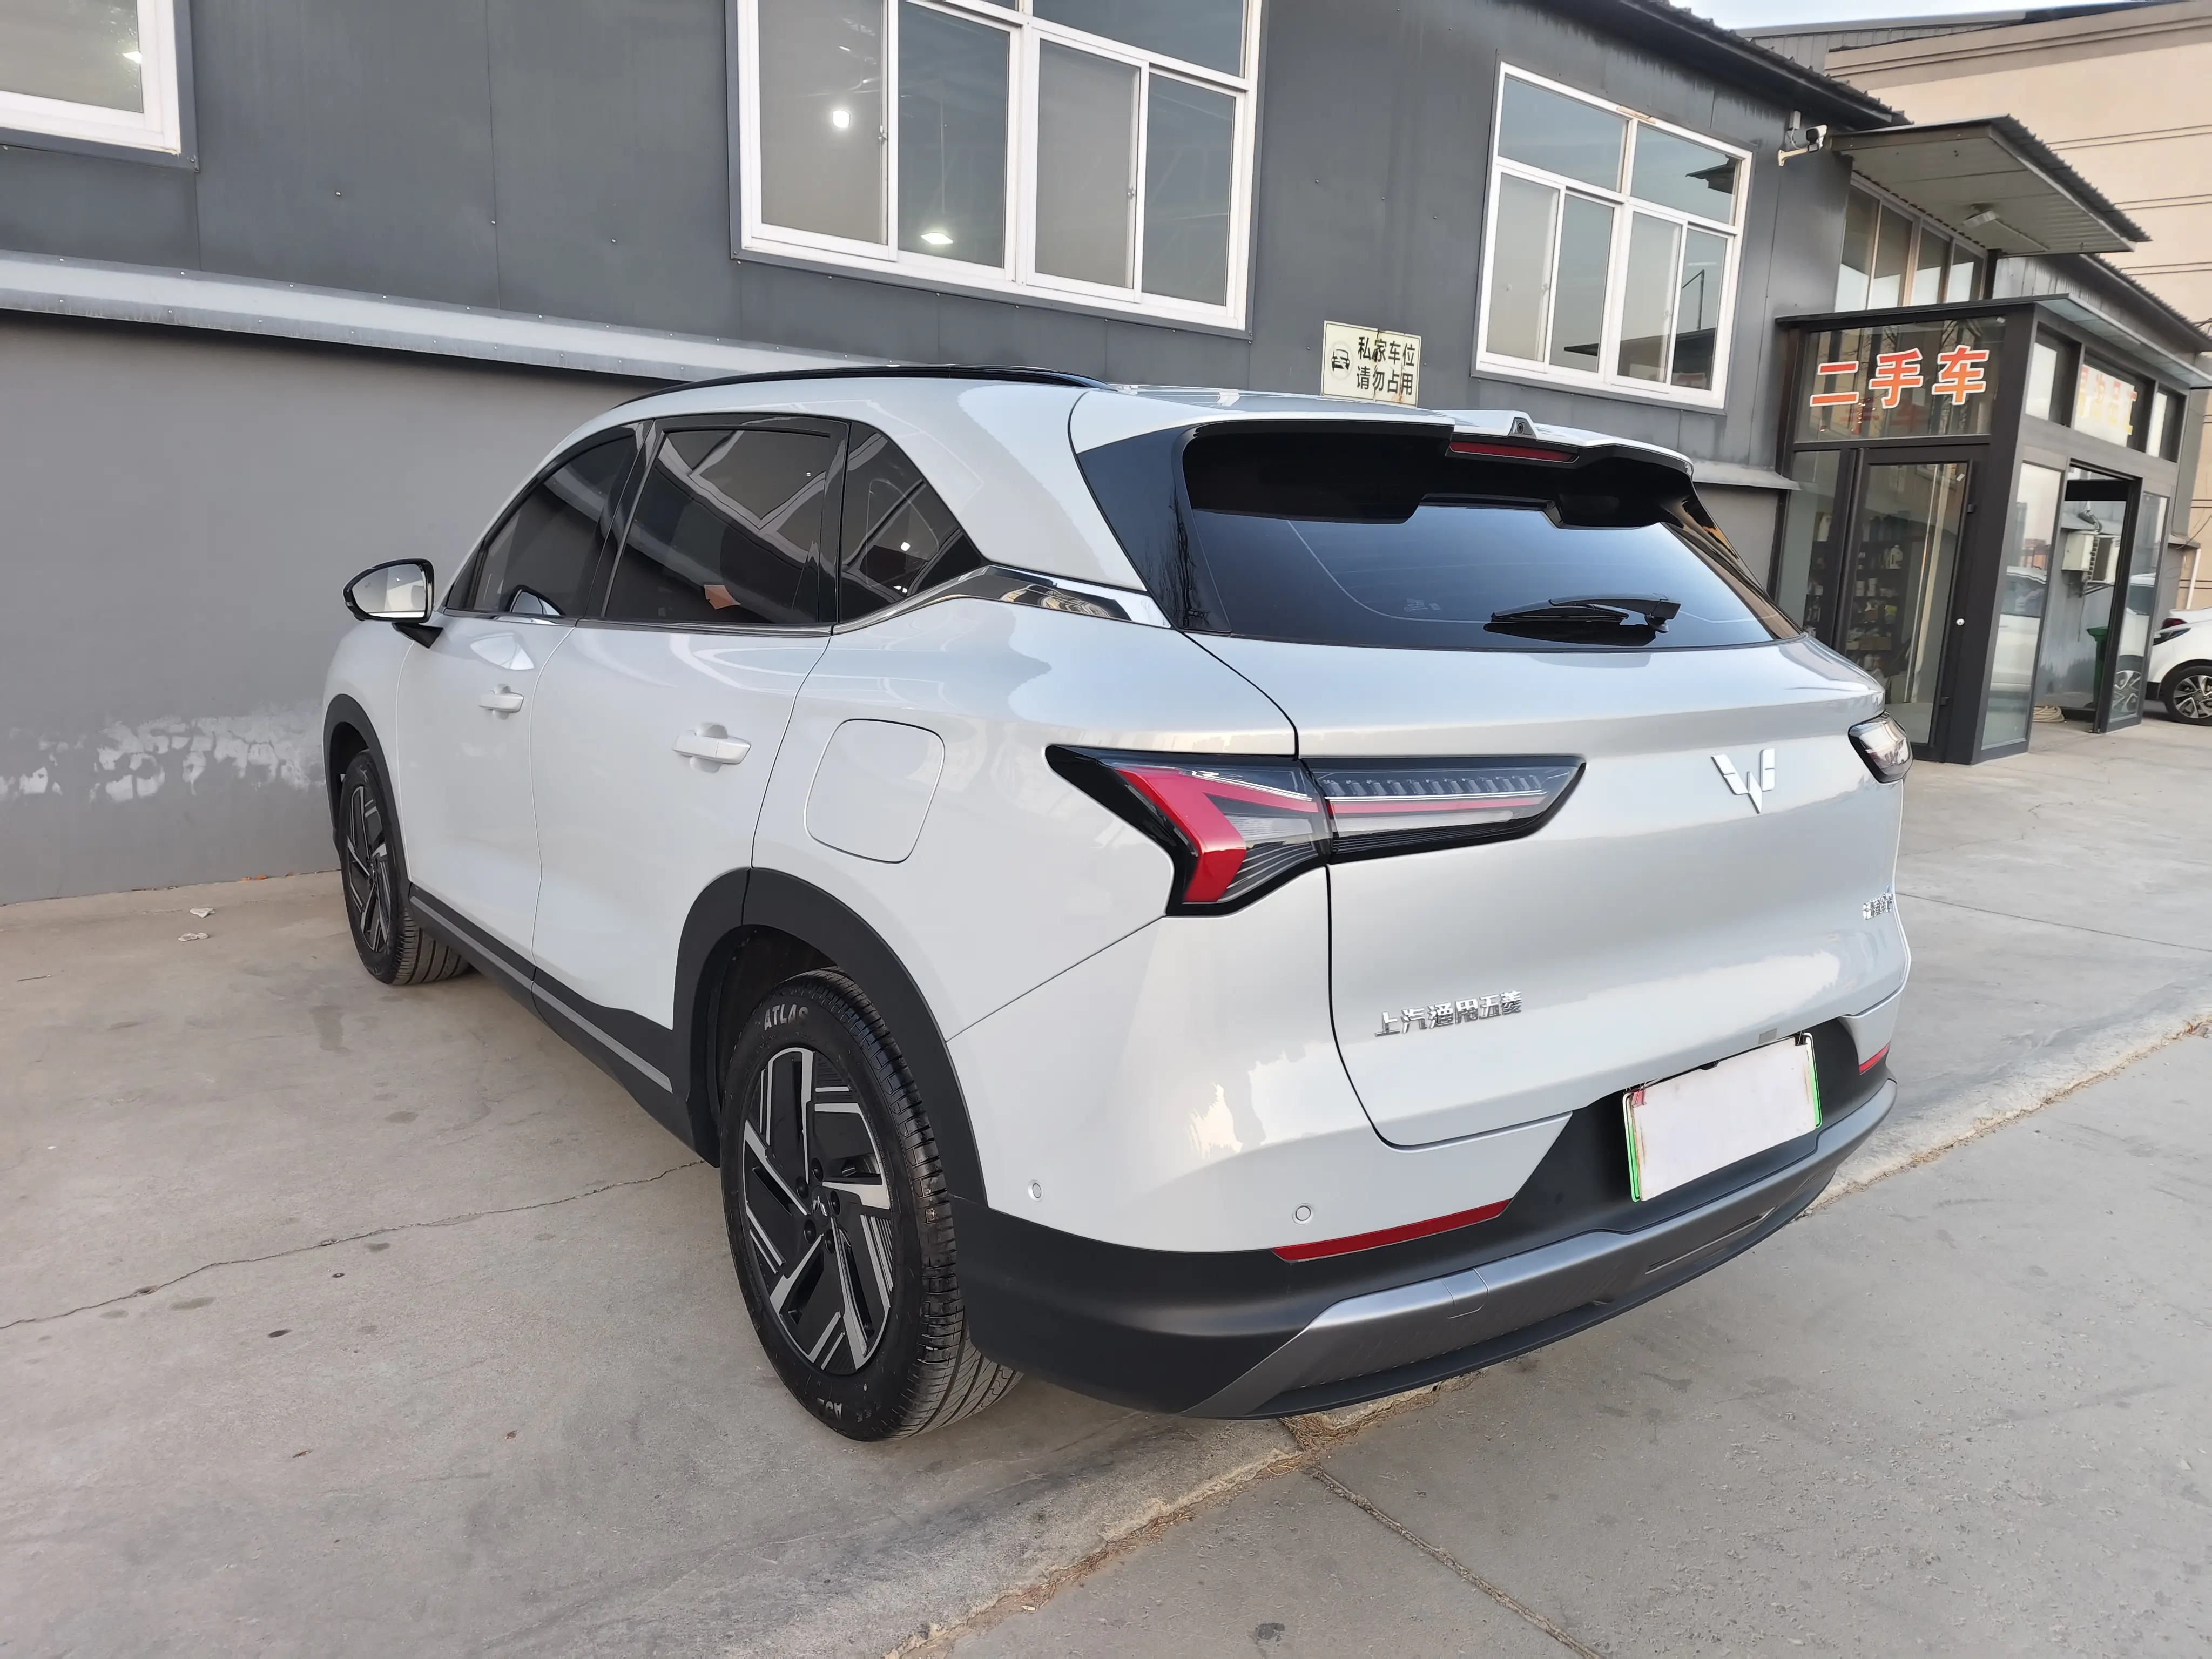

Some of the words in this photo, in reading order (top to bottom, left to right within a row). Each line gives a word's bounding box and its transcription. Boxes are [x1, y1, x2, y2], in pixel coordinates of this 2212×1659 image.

[1358, 336, 1415, 367] 私家车位
[1356, 365, 1413, 396] 请勿占用
[1810, 345, 1990, 409] 二手车
[763, 1003, 810, 1031] ATLAS
[1374, 989, 1522, 1037] 上汽通用五菱
